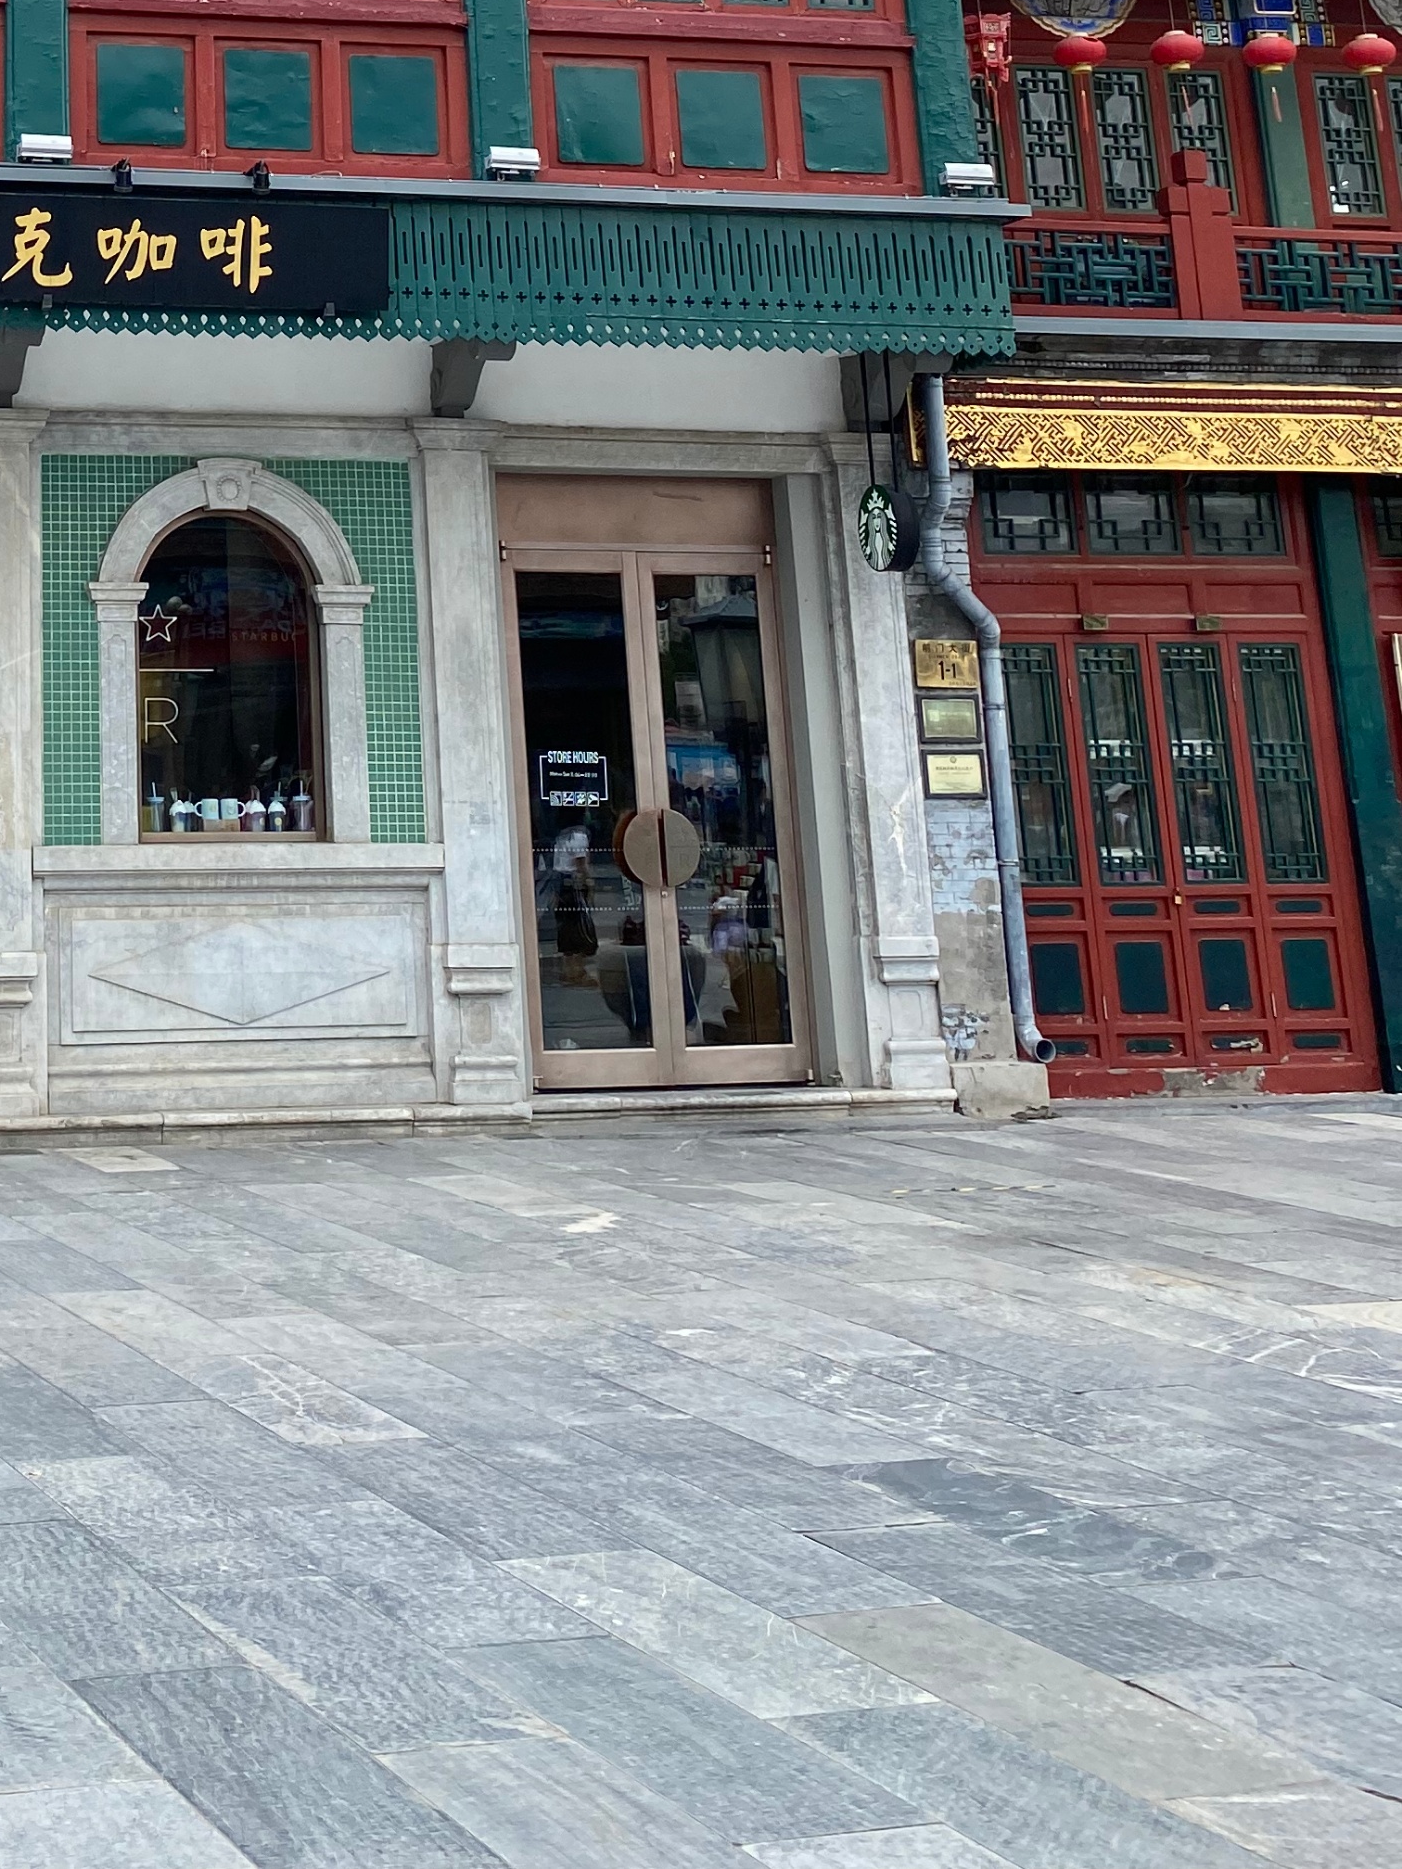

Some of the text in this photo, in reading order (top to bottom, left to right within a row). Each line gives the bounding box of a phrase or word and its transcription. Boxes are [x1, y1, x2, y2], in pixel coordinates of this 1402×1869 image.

[938, 660, 956, 680] 1-1
[144, 697, 179, 744] R
[547, 750, 599, 764] STORE HOURS
